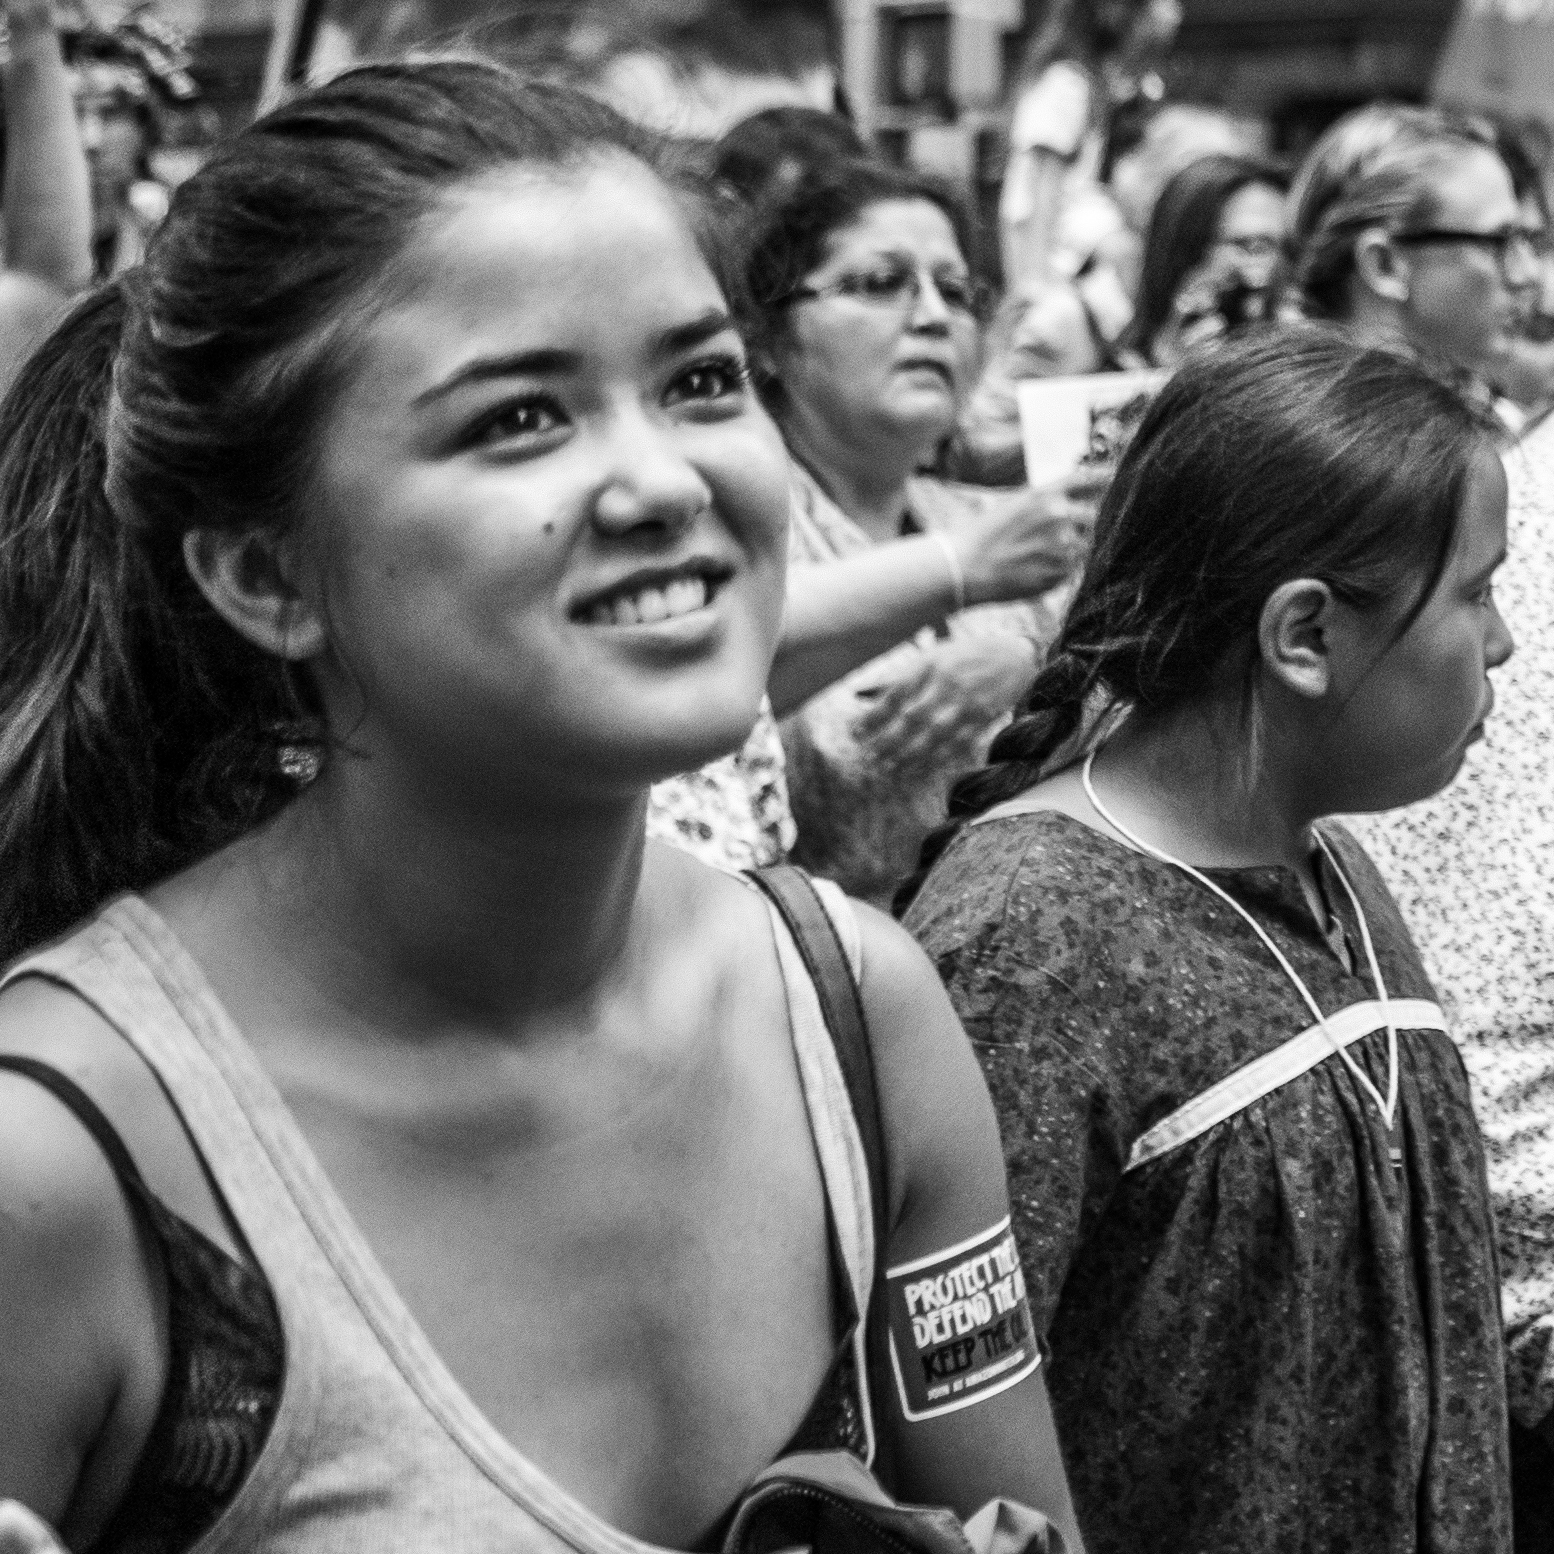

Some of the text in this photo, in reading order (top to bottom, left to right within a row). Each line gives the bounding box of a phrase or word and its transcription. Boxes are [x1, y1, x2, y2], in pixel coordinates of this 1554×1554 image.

[904, 1254, 993, 1316] PROTECT
[912, 1291, 992, 1349] DEFEND
[921, 1335, 975, 1383] KEEP
[978, 1319, 1012, 1358] THE
